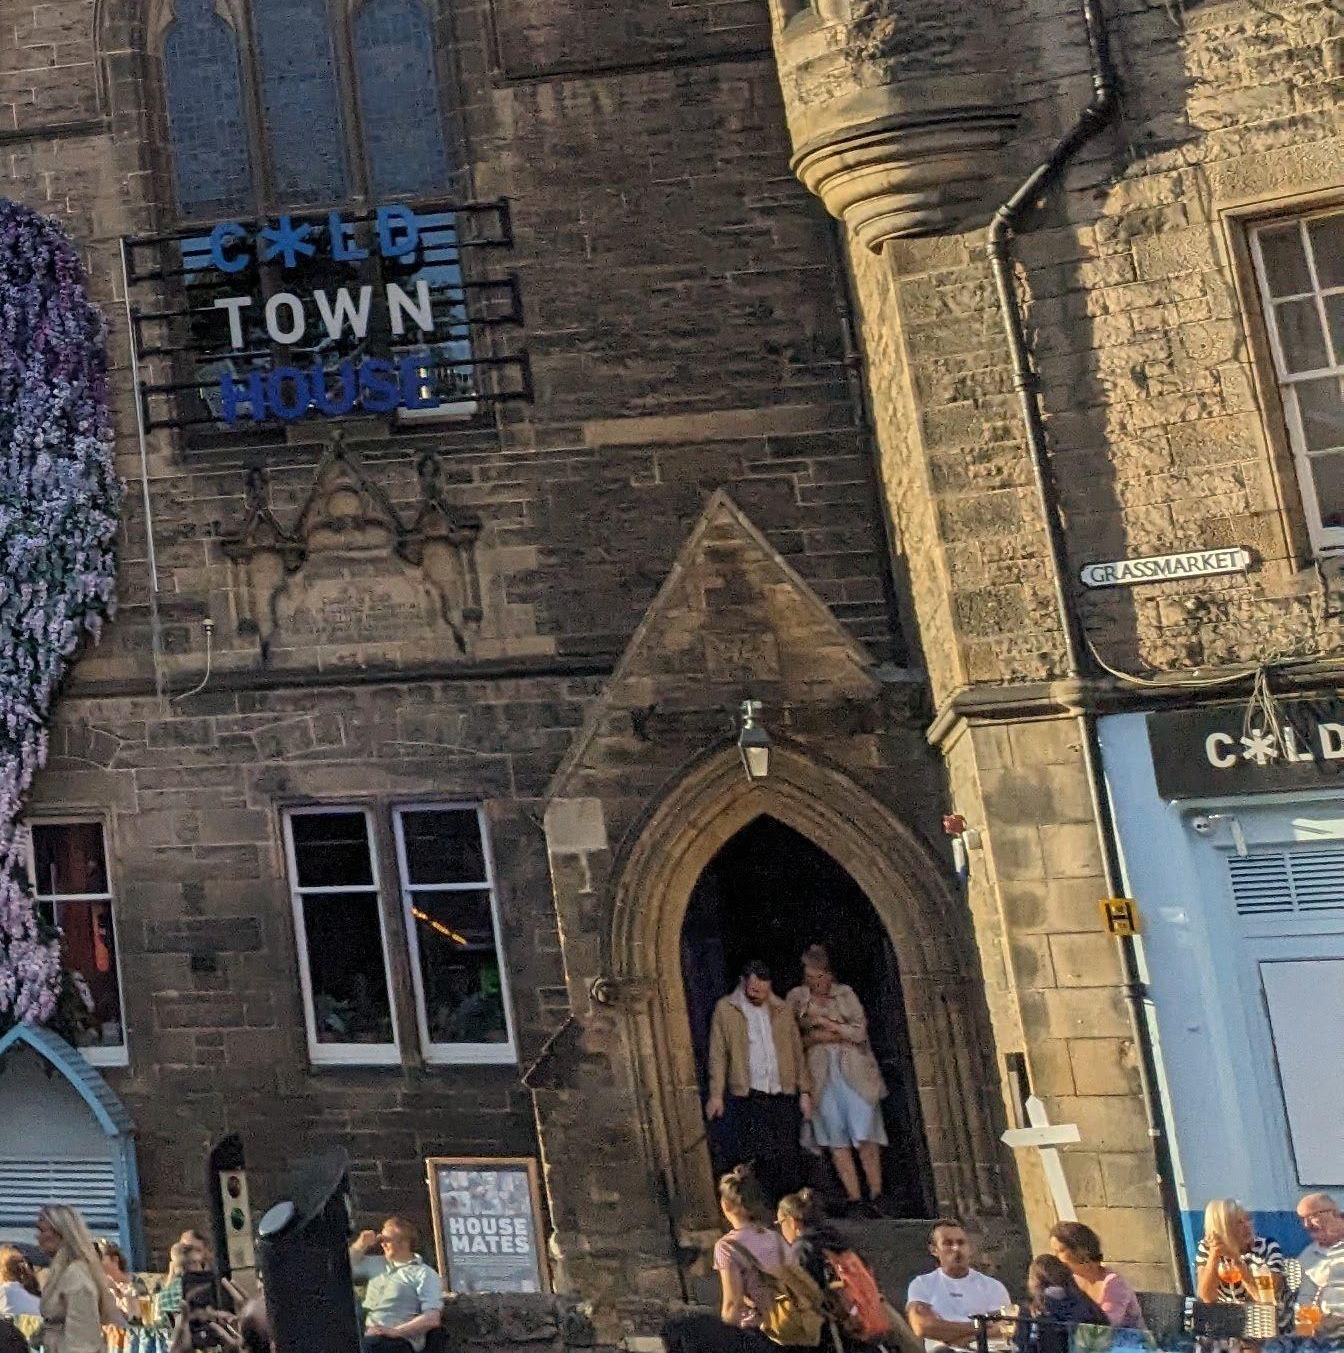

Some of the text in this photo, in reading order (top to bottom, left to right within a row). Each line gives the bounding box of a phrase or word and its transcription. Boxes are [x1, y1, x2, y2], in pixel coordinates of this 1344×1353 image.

[214, 280, 434, 348] TOWN
[220, 357, 440, 425] HOUSE
[1090, 551, 1240, 583] GRASSMARKET
[1104, 901, 1135, 933] H
[449, 1217, 528, 1235] HOUSE
[451, 1235, 530, 1253] MATES
